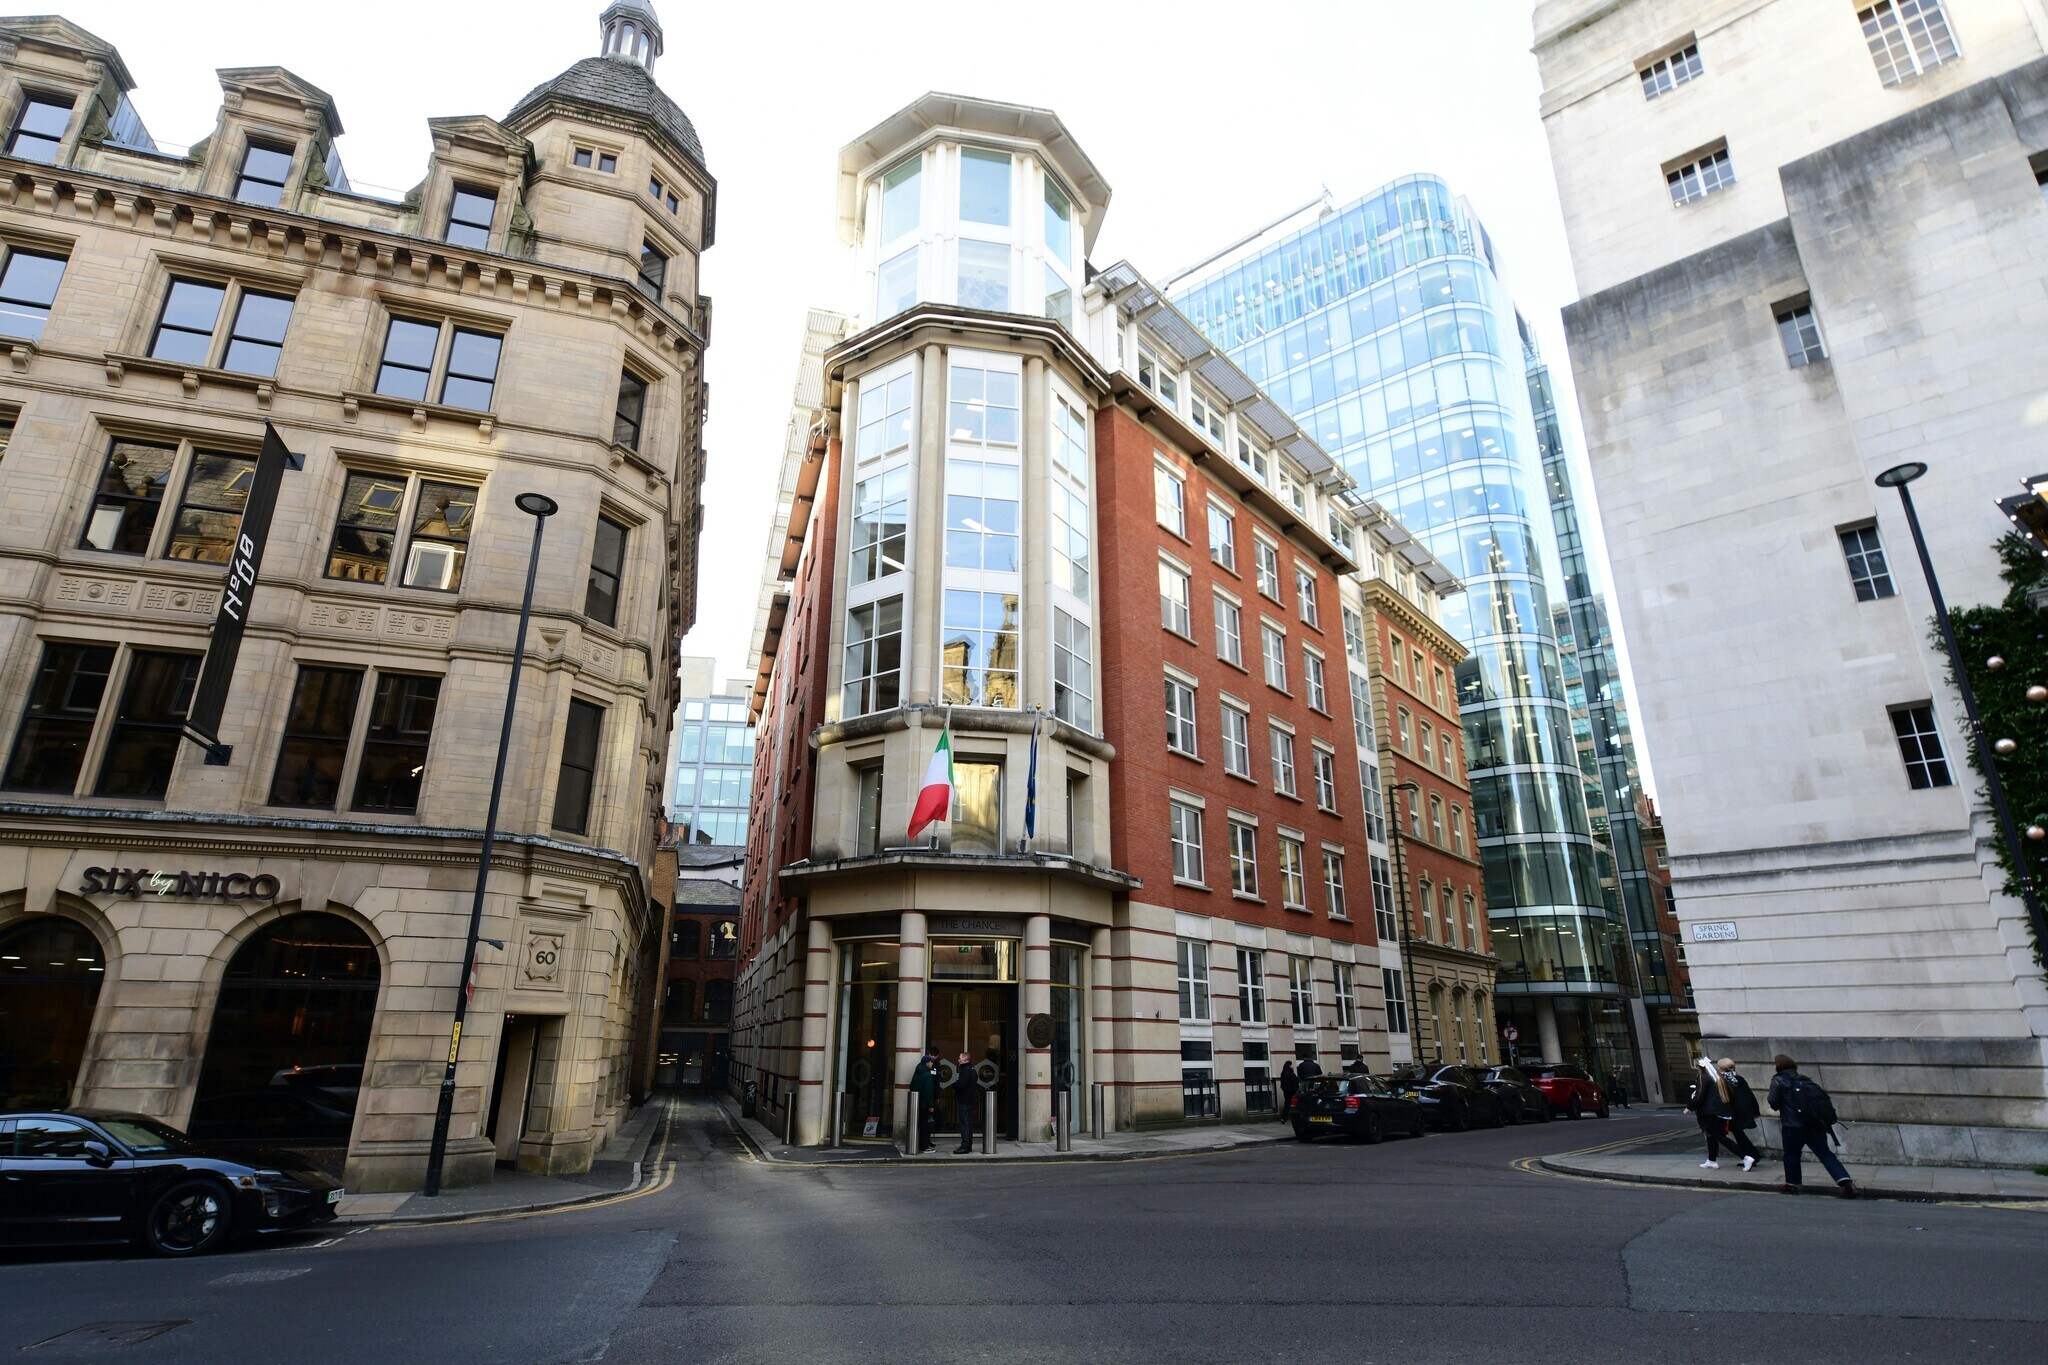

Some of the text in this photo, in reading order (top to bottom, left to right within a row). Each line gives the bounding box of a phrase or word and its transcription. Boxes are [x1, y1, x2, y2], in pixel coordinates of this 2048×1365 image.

[78, 866, 281, 901] SIX by NICO
[940, 919, 958, 929] THE
[1698, 924, 1729, 932] SPRING
[1695, 931, 1736, 940] GARDENS
[535, 950, 556, 965] 60
